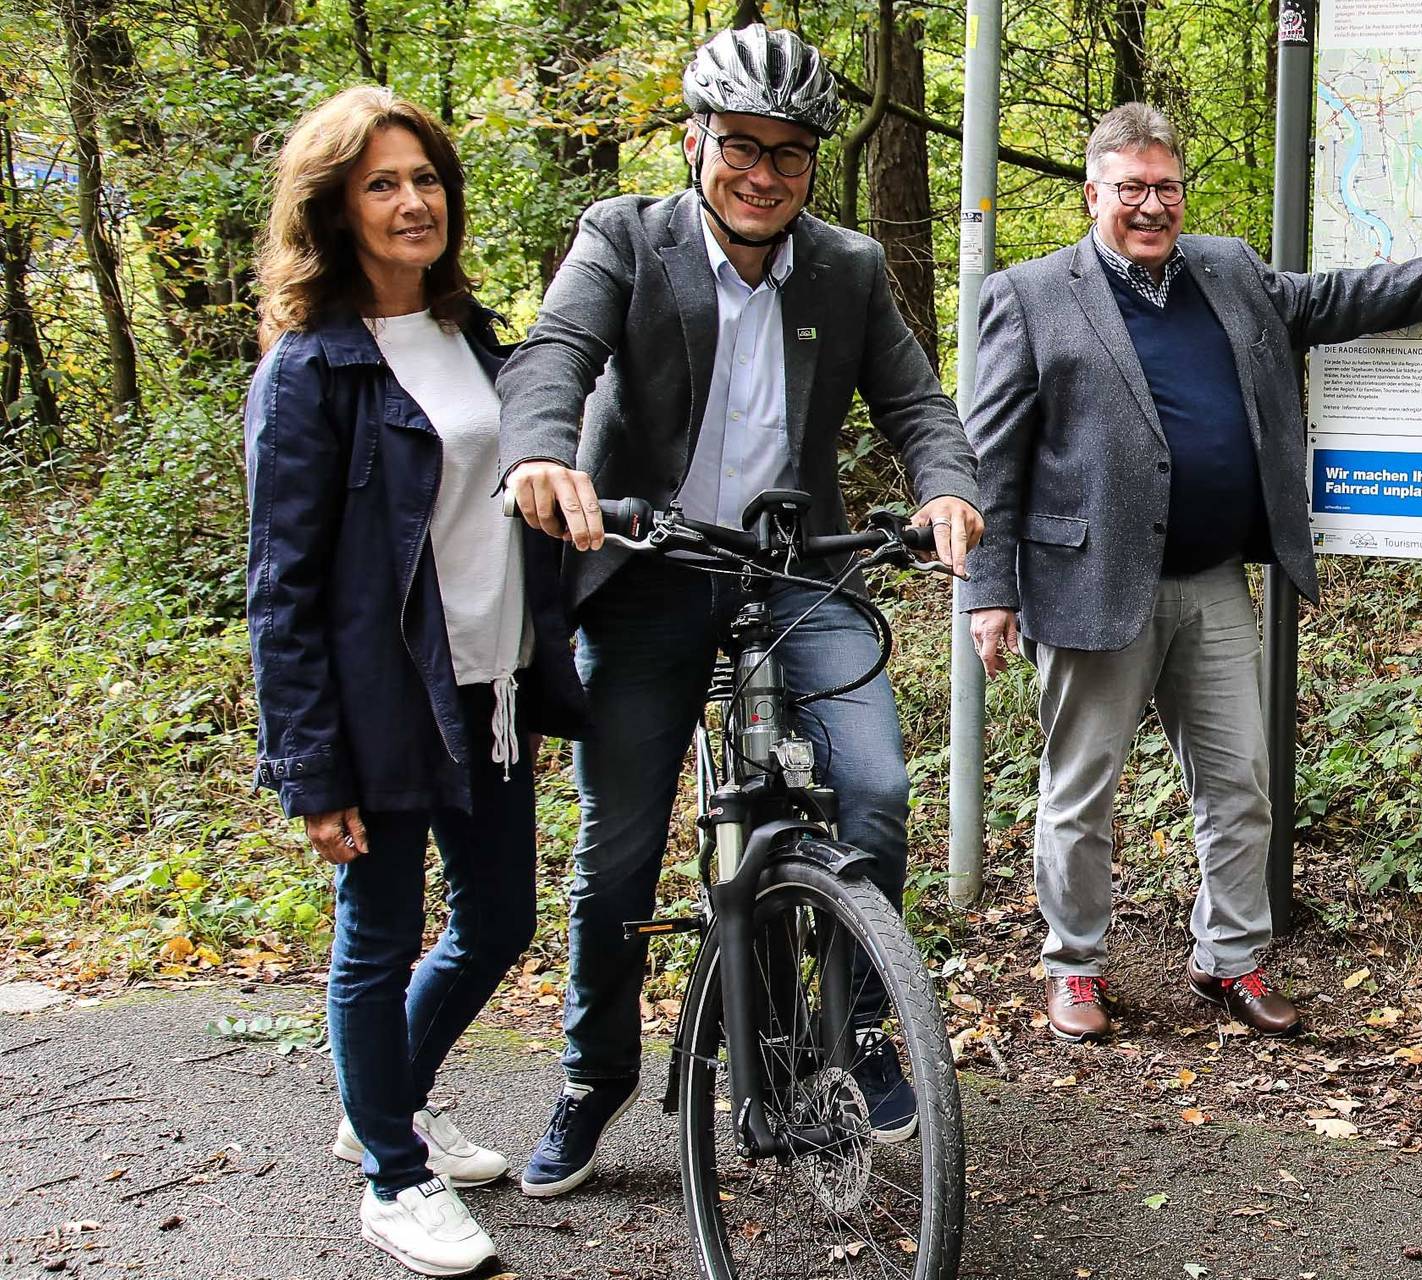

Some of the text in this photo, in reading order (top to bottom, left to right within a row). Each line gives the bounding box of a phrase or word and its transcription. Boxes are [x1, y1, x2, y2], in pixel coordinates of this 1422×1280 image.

[1326, 468, 1350, 480] Wir
[1353, 470, 1408, 482] machen
[1325, 482, 1378, 495] Fahrrad
